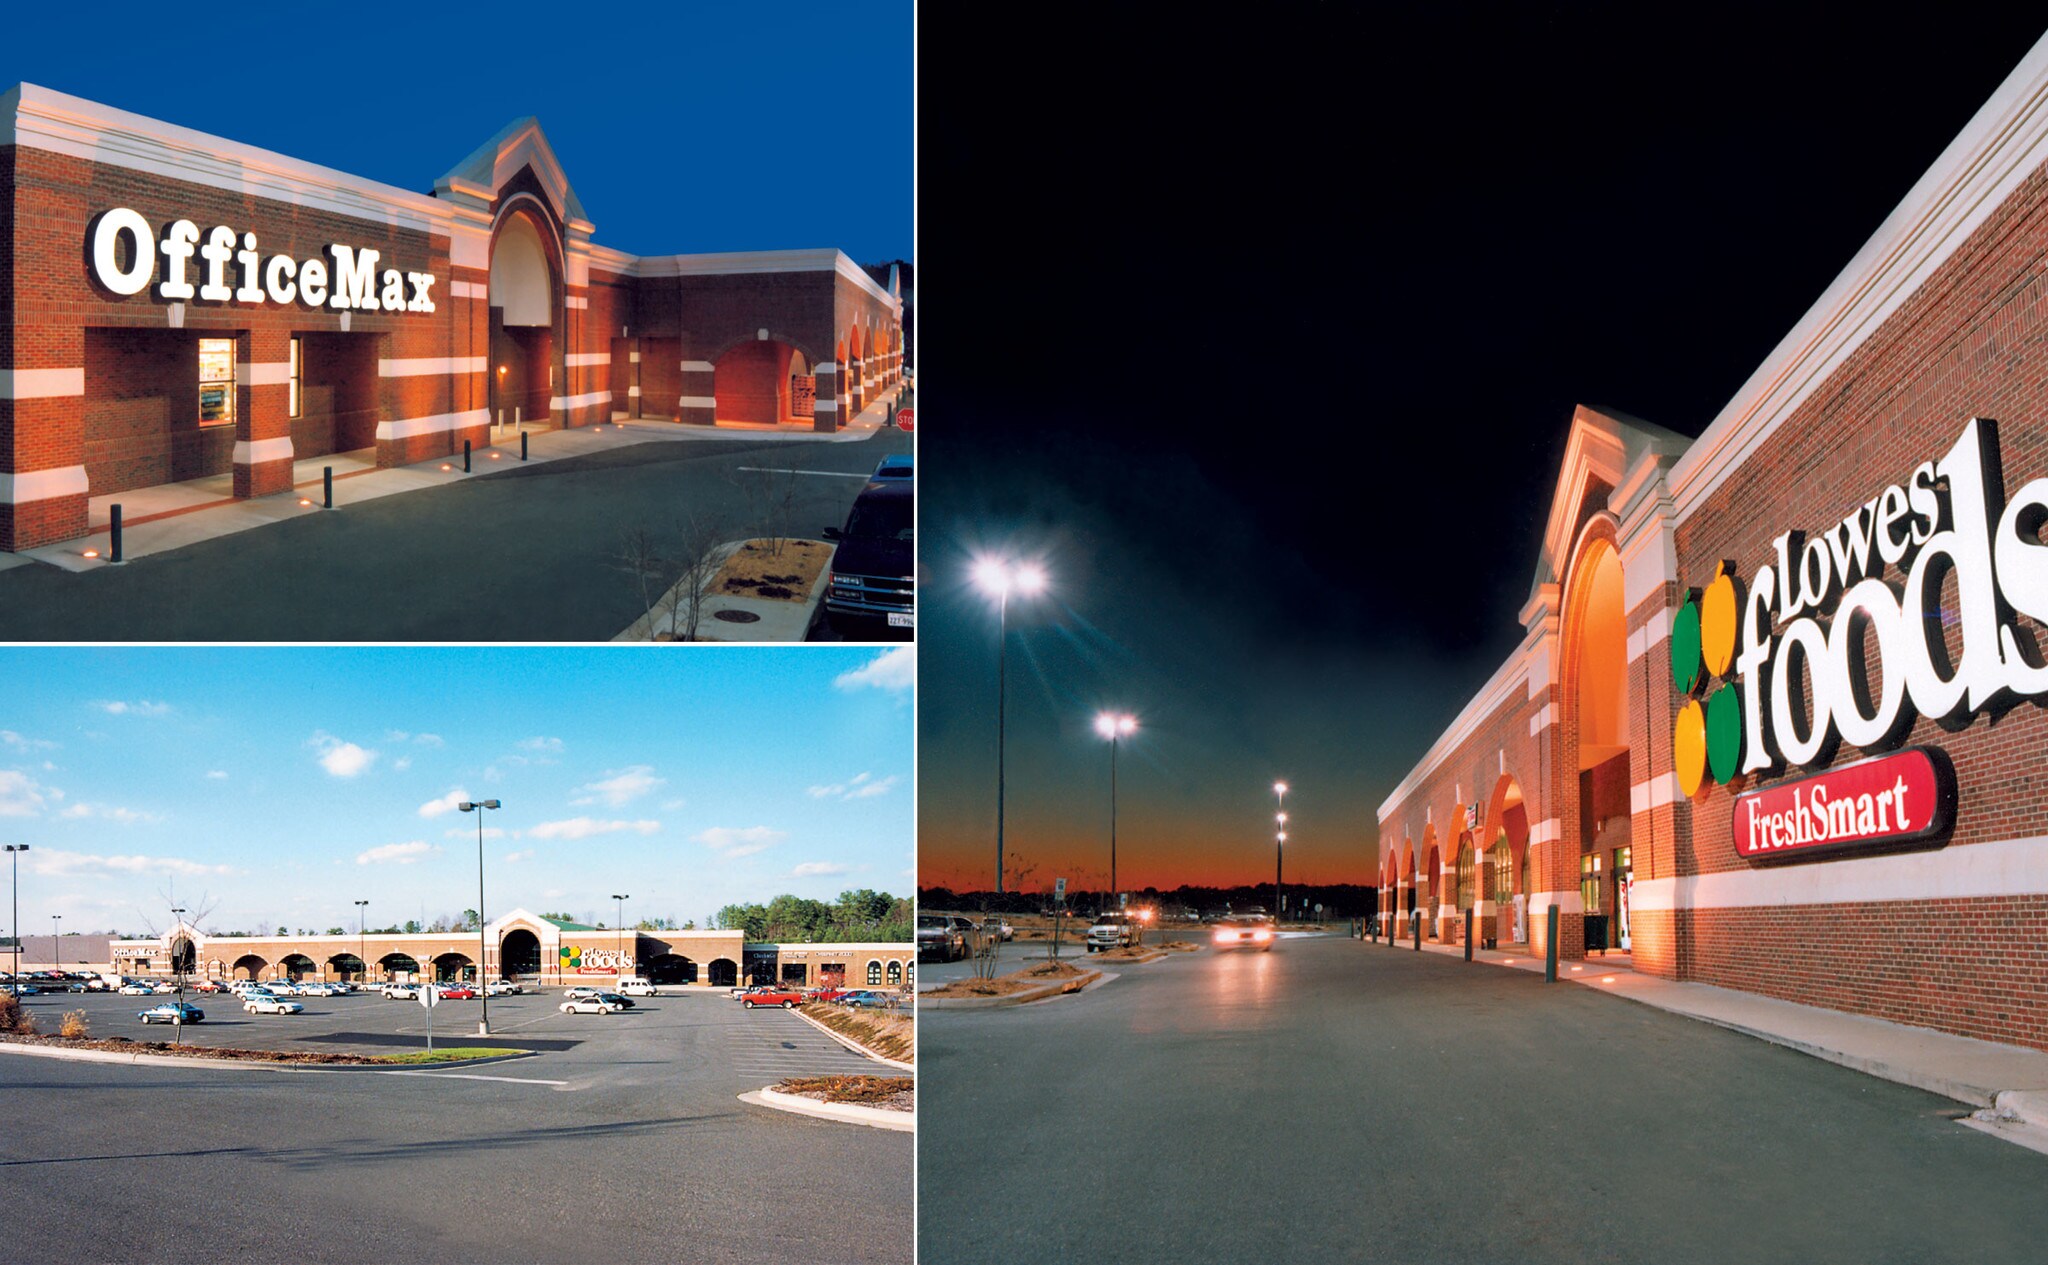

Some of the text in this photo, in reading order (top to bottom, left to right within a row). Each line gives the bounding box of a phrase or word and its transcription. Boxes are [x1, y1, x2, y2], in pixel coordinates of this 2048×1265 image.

[91, 206, 436, 313] OfficeMax
[898, 415, 914, 425] STO
[1773, 460, 1940, 624] Lowes
[1746, 774, 1911, 852] FreshSmart
[579, 948, 635, 969] foods
